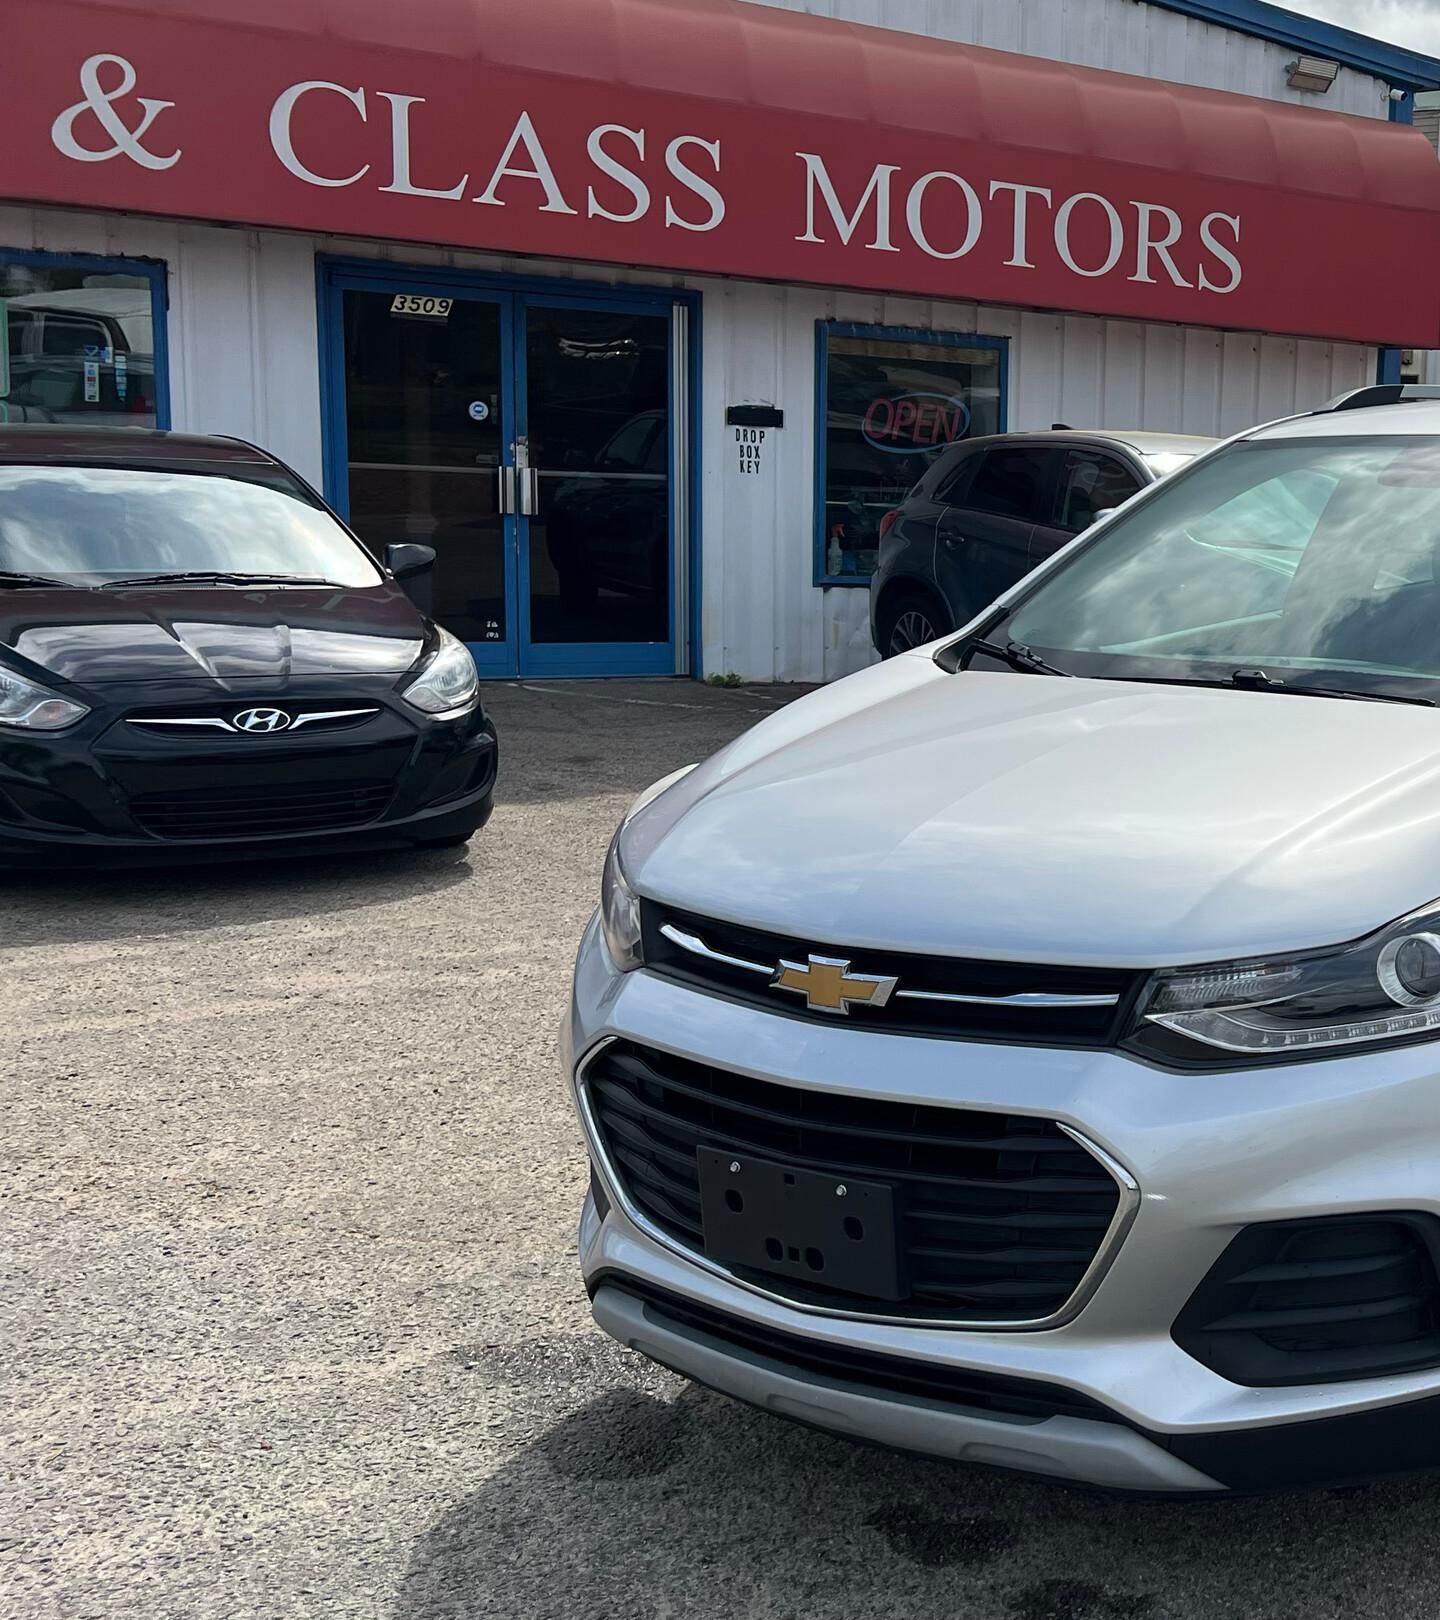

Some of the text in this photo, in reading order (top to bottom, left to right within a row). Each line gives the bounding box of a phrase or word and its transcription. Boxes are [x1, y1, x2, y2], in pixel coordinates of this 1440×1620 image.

[50, 53, 1243, 294] & CLASS MOTORS
[394, 295, 450, 314] 3509
[864, 398, 961, 445] OPEN
[735, 428, 765, 444] DROP
[739, 444, 761, 460] BOX
[739, 459, 760, 475] KEY
